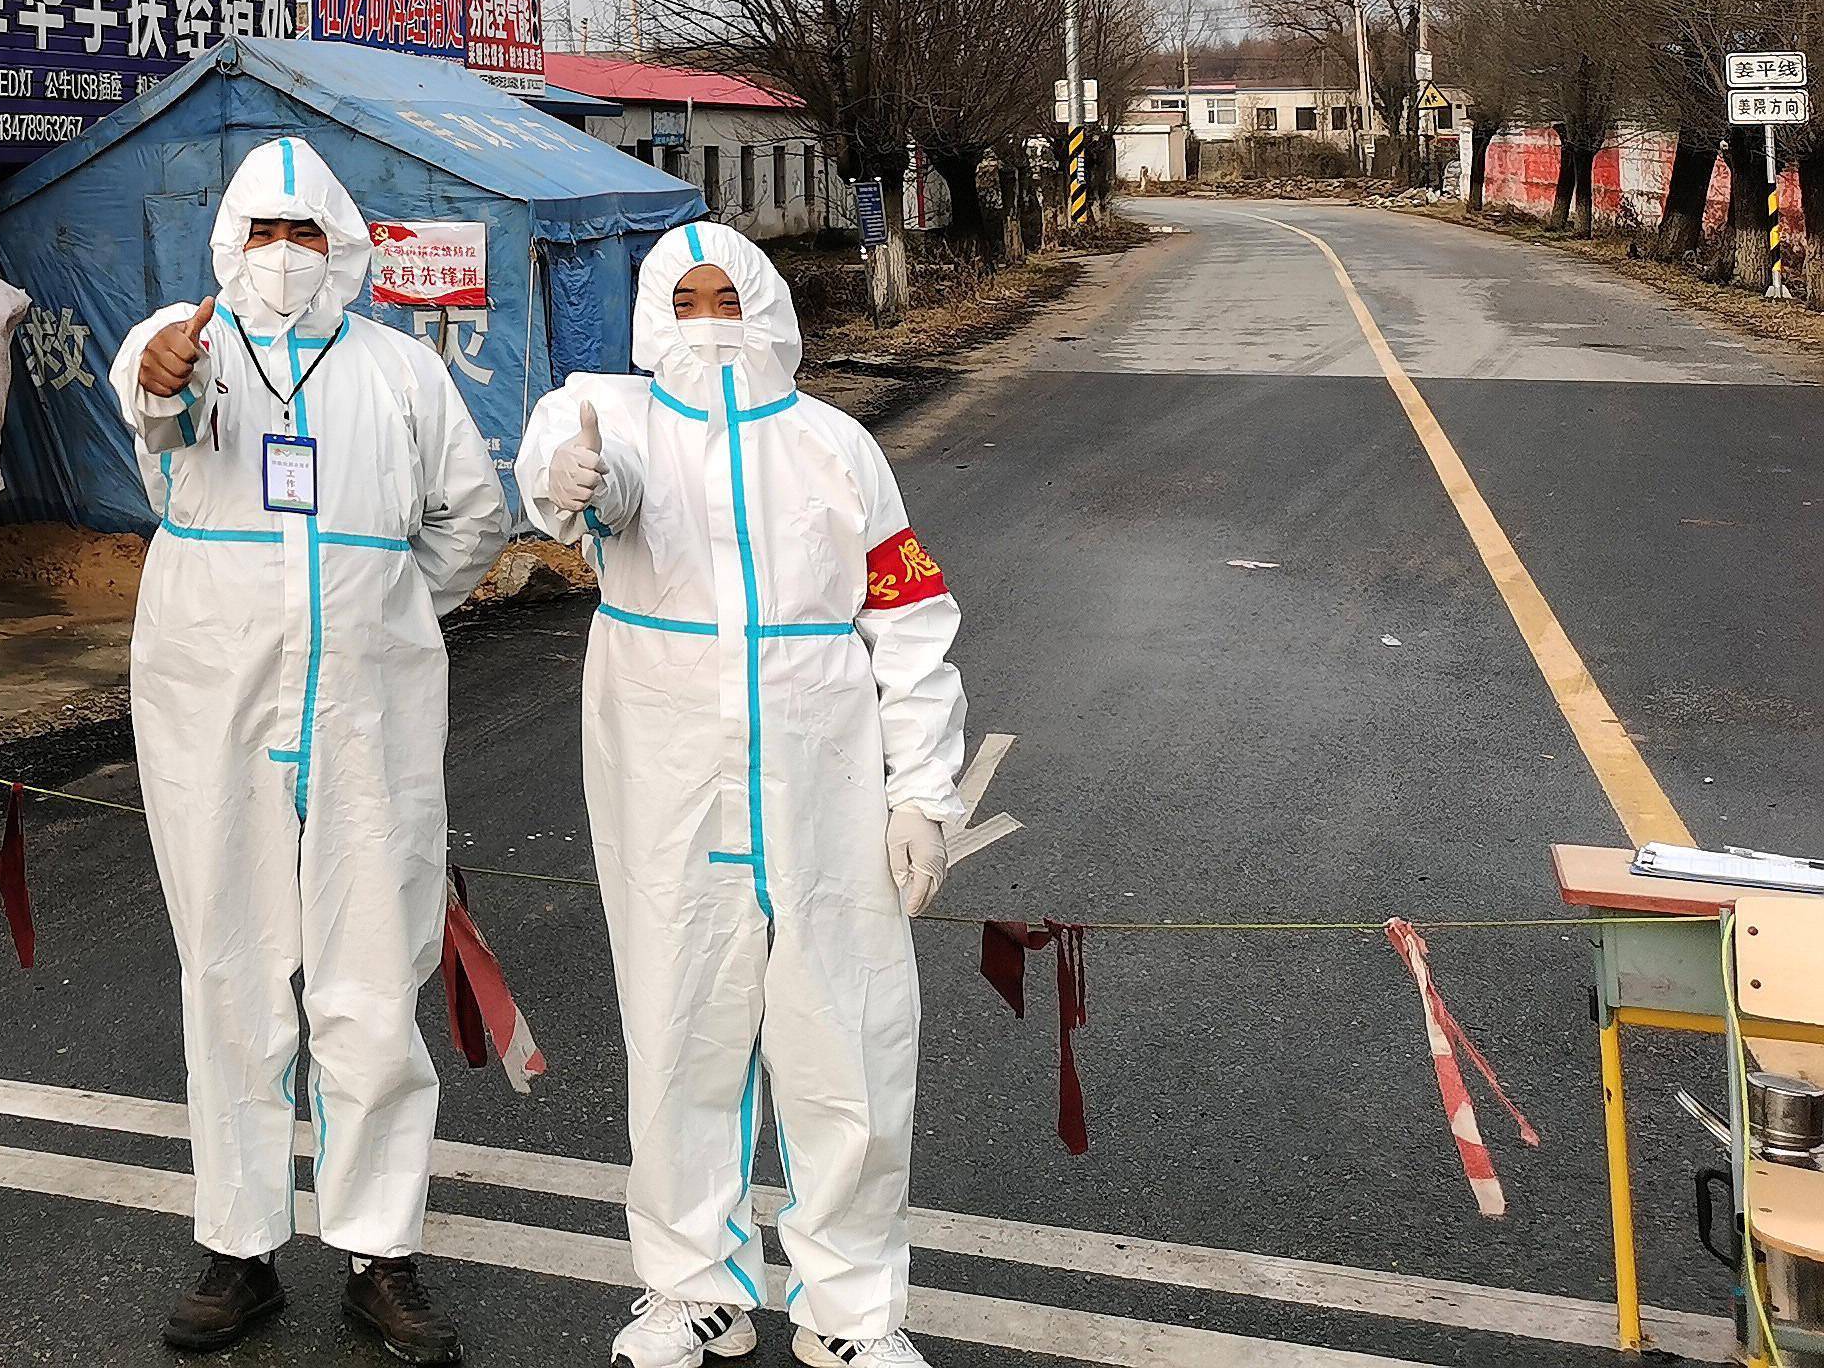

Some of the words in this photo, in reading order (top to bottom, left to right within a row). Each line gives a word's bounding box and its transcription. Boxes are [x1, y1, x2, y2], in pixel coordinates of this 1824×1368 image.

[1734, 60, 1800, 78] 姜平线
[44, 70, 124, 101] 公牛USB插座
[380, 265, 478, 288] 党员先锋岗
